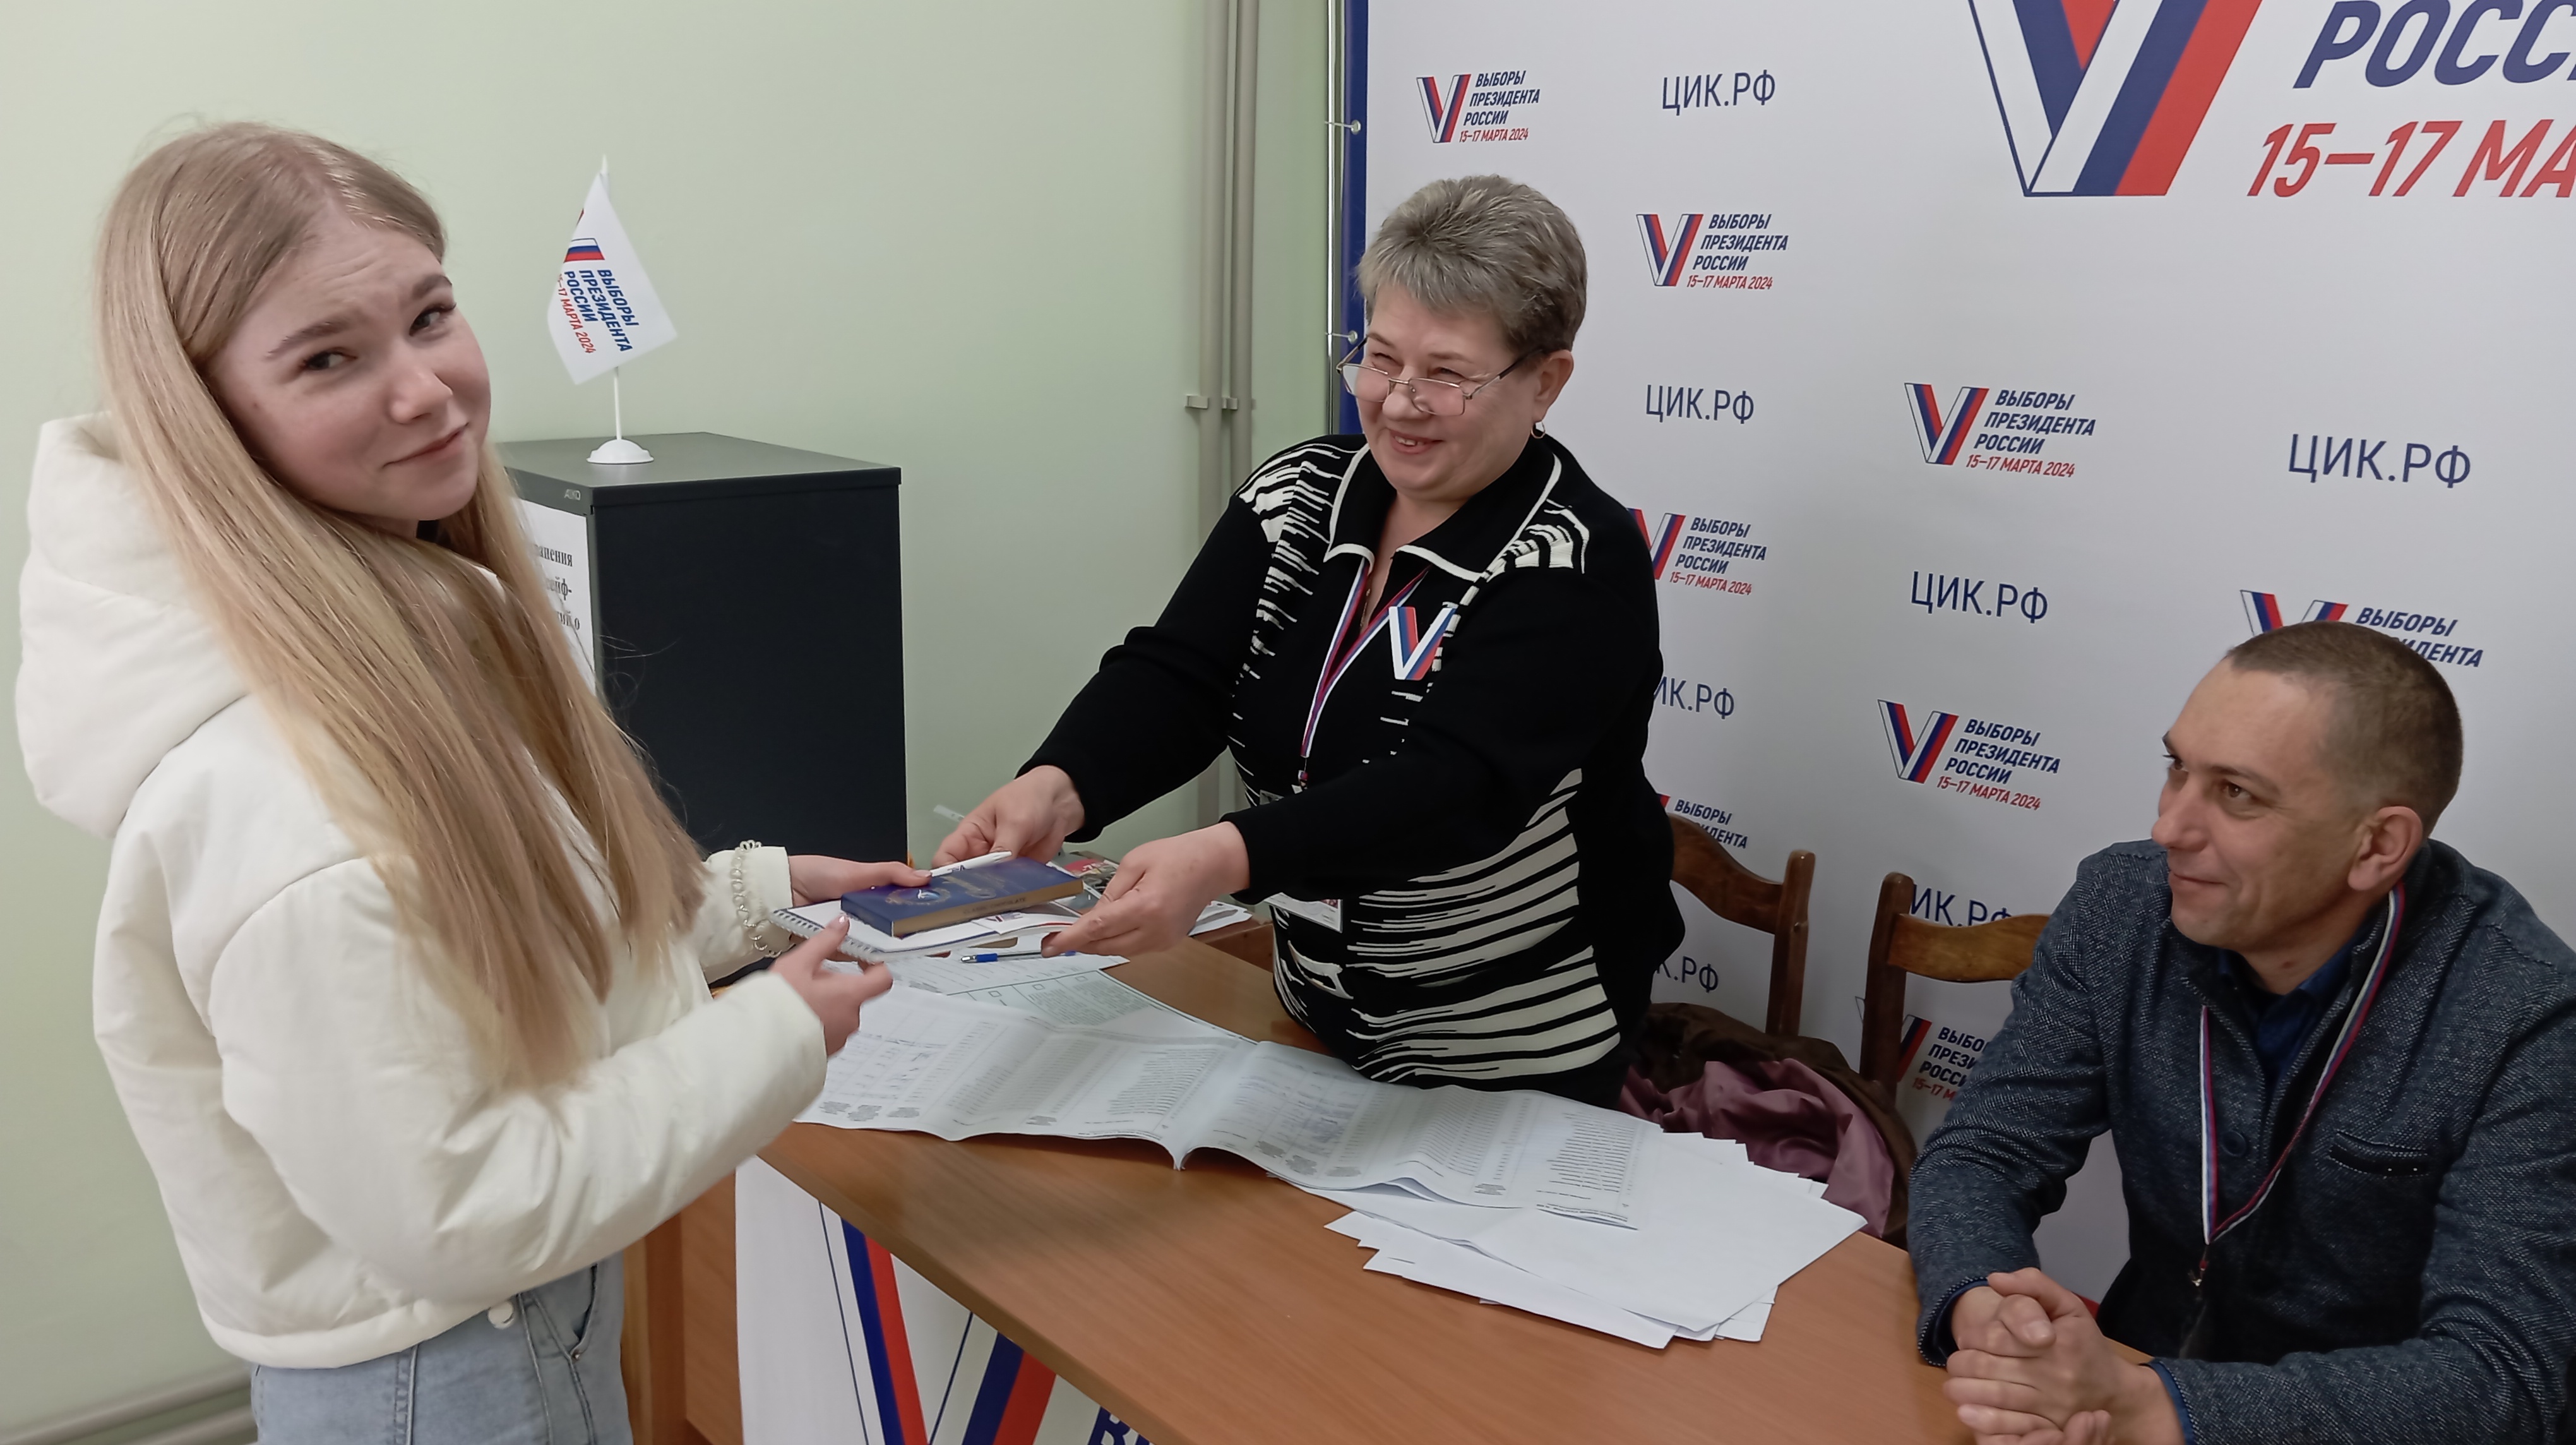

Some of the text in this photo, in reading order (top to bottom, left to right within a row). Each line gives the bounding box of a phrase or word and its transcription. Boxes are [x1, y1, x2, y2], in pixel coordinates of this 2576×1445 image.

[2293, 0, 2576, 88] РОСС
[1475, 70, 1526, 87] ВЫБОРЫ
[1469, 89, 1541, 107] ПРЕЗИДЕНТА
[1662, 69, 1775, 116] ЦИК.РФ
[1463, 111, 1509, 126] РОССИИ
[1481, 129, 1508, 141] МАРТА
[1508, 128, 1529, 141] 2024
[2452, 119, 2576, 198] МА
[1708, 213, 1772, 229] ВЫБОРЫ
[1700, 235, 1789, 252] ПРЕЗИДЕНТА
[1693, 255, 1749, 271] РОССИИ
[1713, 276, 1747, 289] МАРТА
[1748, 277, 1773, 290] 2024
[564, 271, 599, 322] РОССИИ
[597, 270, 640, 326] ВЫБОРЫ
[579, 270, 633, 352] ПРЕЗИДЕНТА
[561, 299, 583, 330] МАРТА
[575, 332, 596, 353] 2024
[1646, 385, 1754, 424] ЦИК.РФ
[1995, 389, 2075, 411] ВЫБОРЫ
[1984, 412, 2096, 436] ПРЕЗИДЕНТА
[1973, 433, 2045, 455] РОССИИ
[2000, 457, 2043, 474] МАРТА
[2043, 462, 2075, 478] 2024
[2289, 433, 2471, 488] ЦИК.РФ
[1690, 517, 1751, 537] ВЫБОРЫ
[1683, 536, 1767, 561] ПРЕЗИДЕНТА
[1675, 554, 1729, 574] РОССИИ
[1695, 575, 1728, 592] МАРТА
[1728, 581, 1752, 596] 2024
[1911, 571, 2048, 623] ЦИК.РФ
[2356, 608, 2458, 637] ВЫБОРЫ
[1654, 676, 1734, 719] ИК.РФ
[1964, 719, 2041, 747] ВЫБОРЫ
[1954, 738, 2061, 774] ПРЕЗИДЕНТА
[1944, 757, 2012, 784] РОССИИ
[1969, 783, 2010, 803] МАРТА
[2010, 793, 2041, 811] 2024
[1674, 799, 1732, 825] ВЫБОРЫ
[1938, 1026, 1986, 1052] ВЫБО
[1928, 1043, 1977, 1070] ПРЕЗИ
